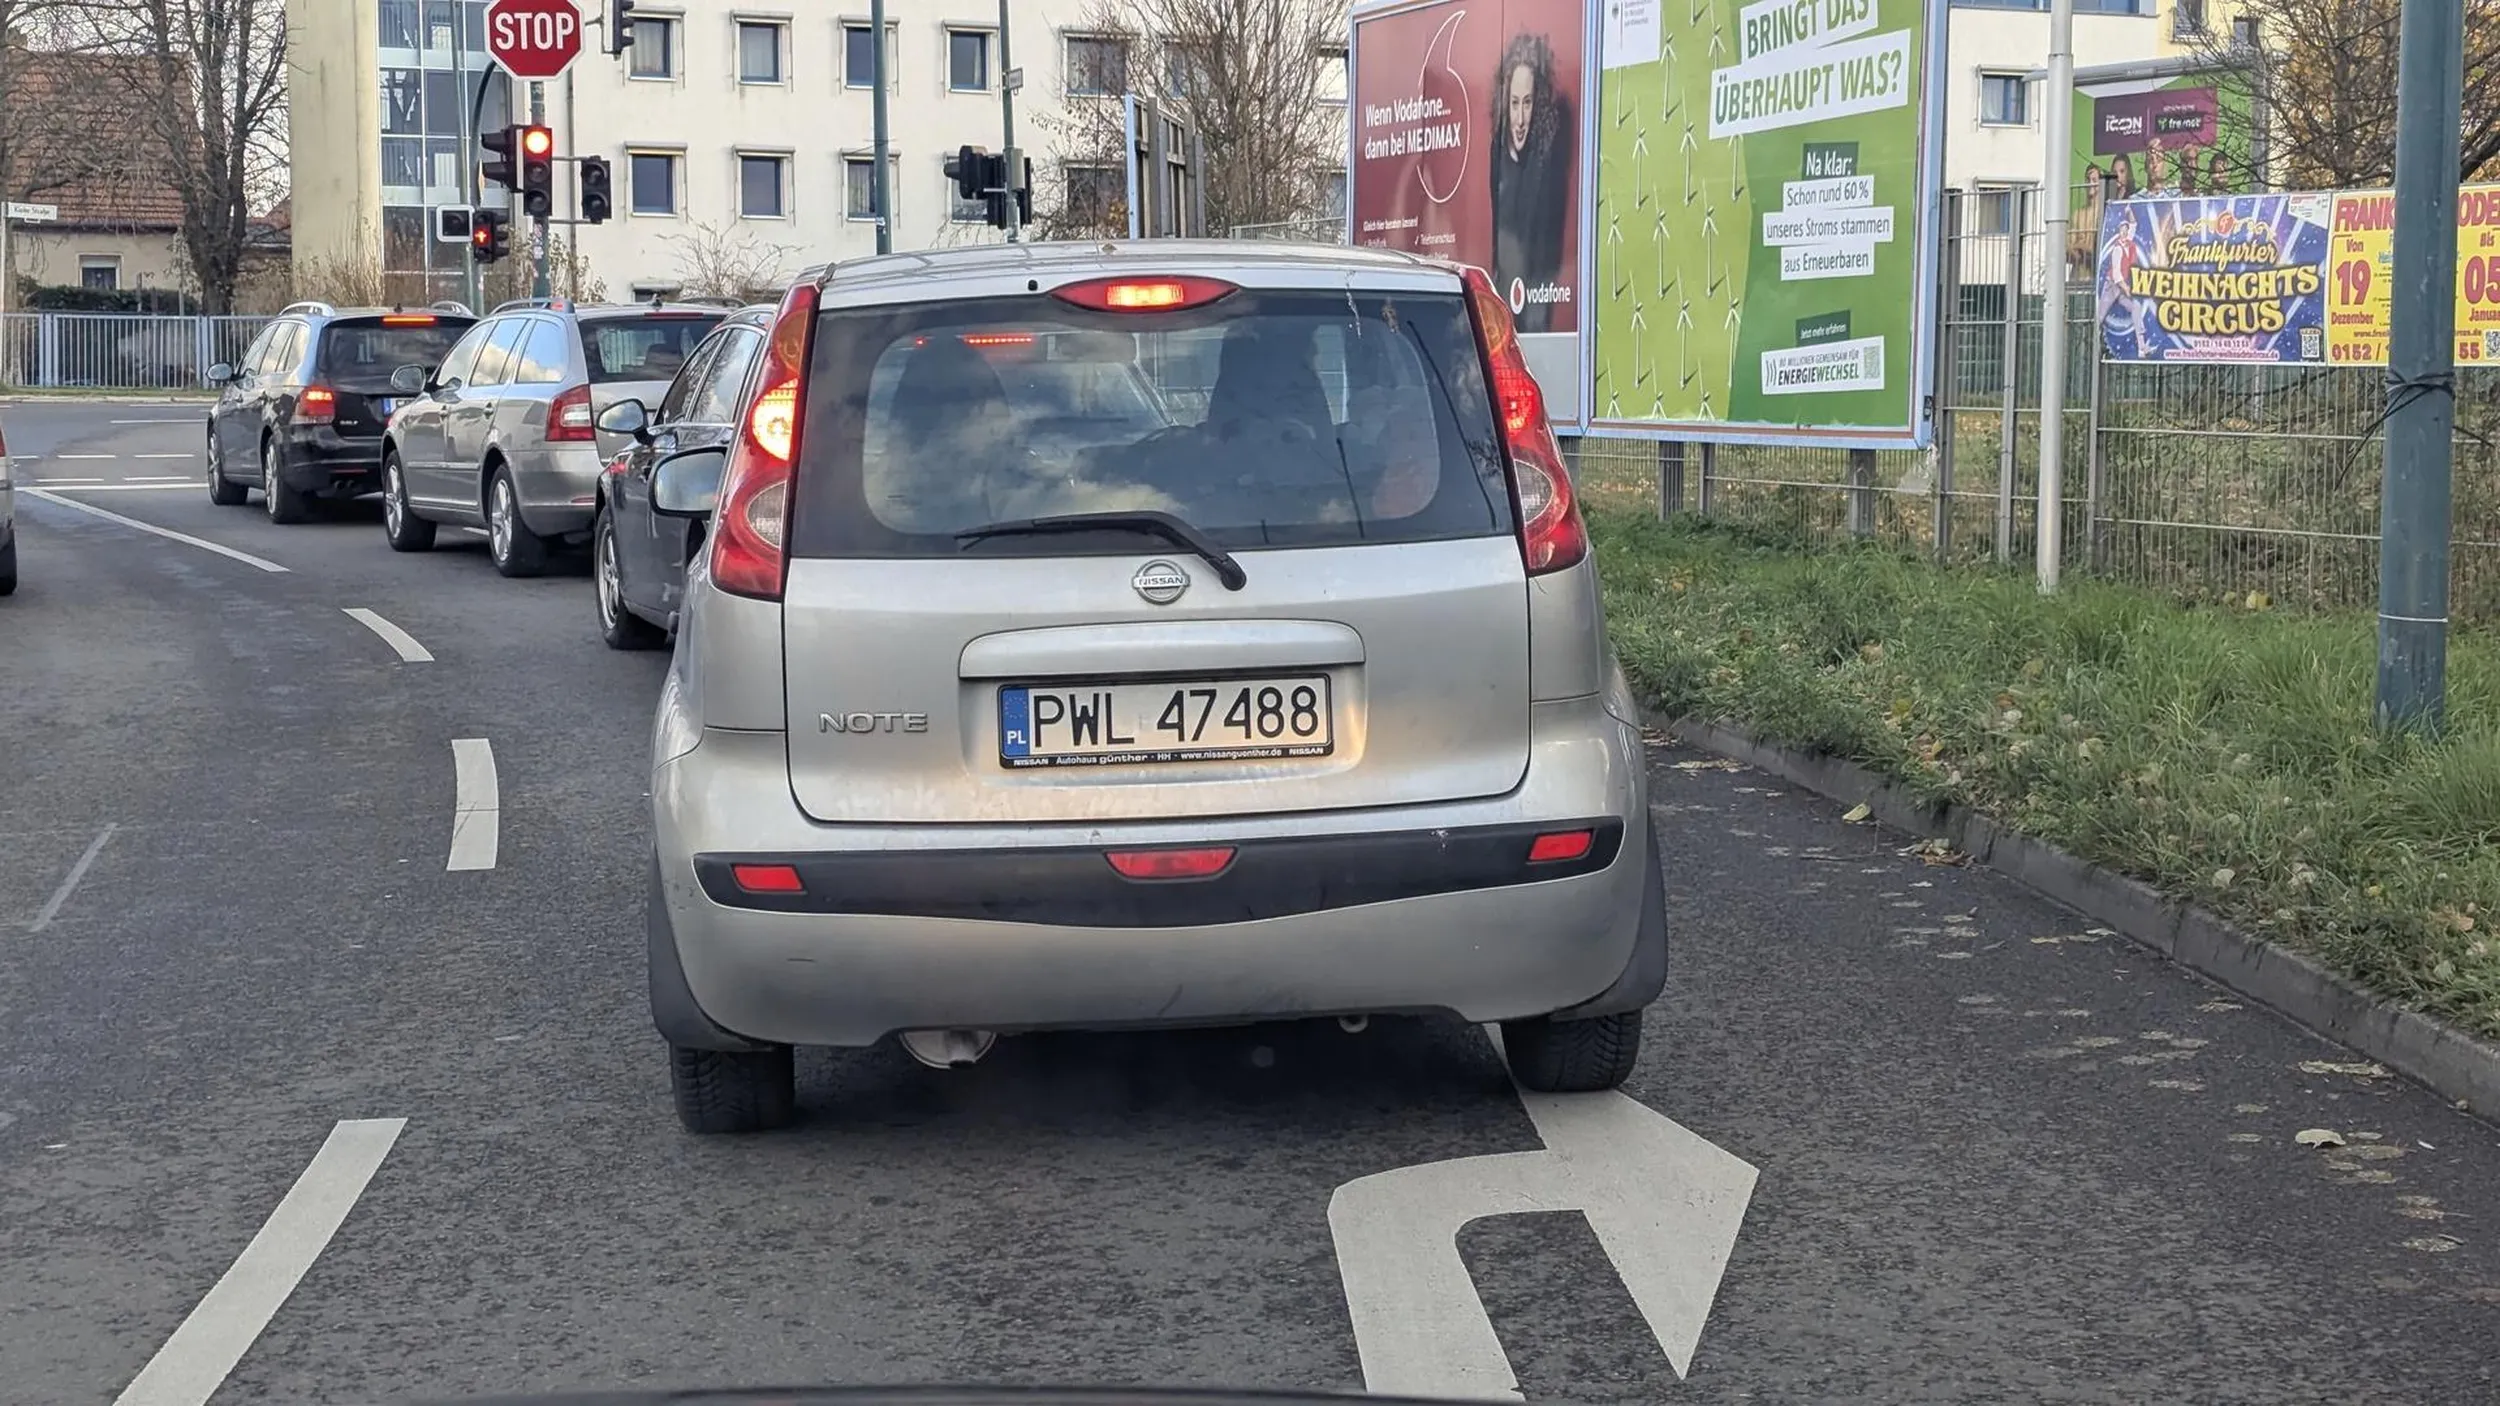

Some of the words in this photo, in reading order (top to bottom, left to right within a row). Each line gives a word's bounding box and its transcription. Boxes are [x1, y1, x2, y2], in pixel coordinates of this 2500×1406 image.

[495, 12, 575, 50] STOP
[1747, 0, 1820, 59] BRINGT
[1826, 0, 1870, 31] DAS
[1715, 64, 1834, 125] ÜBERHAUPT
[1840, 50, 1901, 102] WAS?
[1365, 104, 1392, 128] Wenn
[1393, 95, 1452, 123] Vodafone...
[1365, 136, 1389, 160] dann
[1390, 131, 1406, 156] bei
[1407, 122, 1461, 154] MEDIMAX
[1805, 151, 1822, 176] Na
[1823, 150, 1853, 176] klar:
[1786, 187, 1817, 207] Schon
[1819, 181, 1842, 203] rund
[1844, 181, 1857, 201] 60
[1859, 180, 1870, 199] %
[1766, 221, 1804, 239] unseres
[1805, 218, 1839, 237] Stroms
[1840, 218, 1890, 235] stammen
[2480, 231, 2495, 247] Bis
[2167, 236, 2278, 272] Frankfurter
[2346, 239, 2364, 252] Von
[1784, 258, 1801, 273] aus
[1802, 249, 1869, 271] Erneuerbaren
[2130, 264, 2320, 300] WEIHNACHTS
[2336, 260, 2371, 305] 19
[2465, 255, 2500, 304] 05
[1526, 282, 1571, 303] vodafone
[2158, 300, 2285, 335] CIRCUS
[2331, 311, 2374, 325] Dezember
[2331, 343, 2372, 361] 0152
[2458, 342, 2481, 359] 55
[1778, 362, 1860, 387] ENERGIEWECHSEL
[1139, 576, 1184, 586] NISSAN
[819, 712, 928, 733] NOTE
[1034, 693, 1135, 748] PWL
[1156, 685, 1319, 743] 47488
[1007, 730, 1027, 745] PL
[1013, 758, 1049, 766] NISSAN
[1056, 756, 1097, 765] Autohaus
[1099, 754, 1148, 764] günther
[1157, 753, 1171, 761] HH
[1180, 749, 1282, 760] www.nissanguenther.de
[1288, 746, 1324, 756] NISSAN
